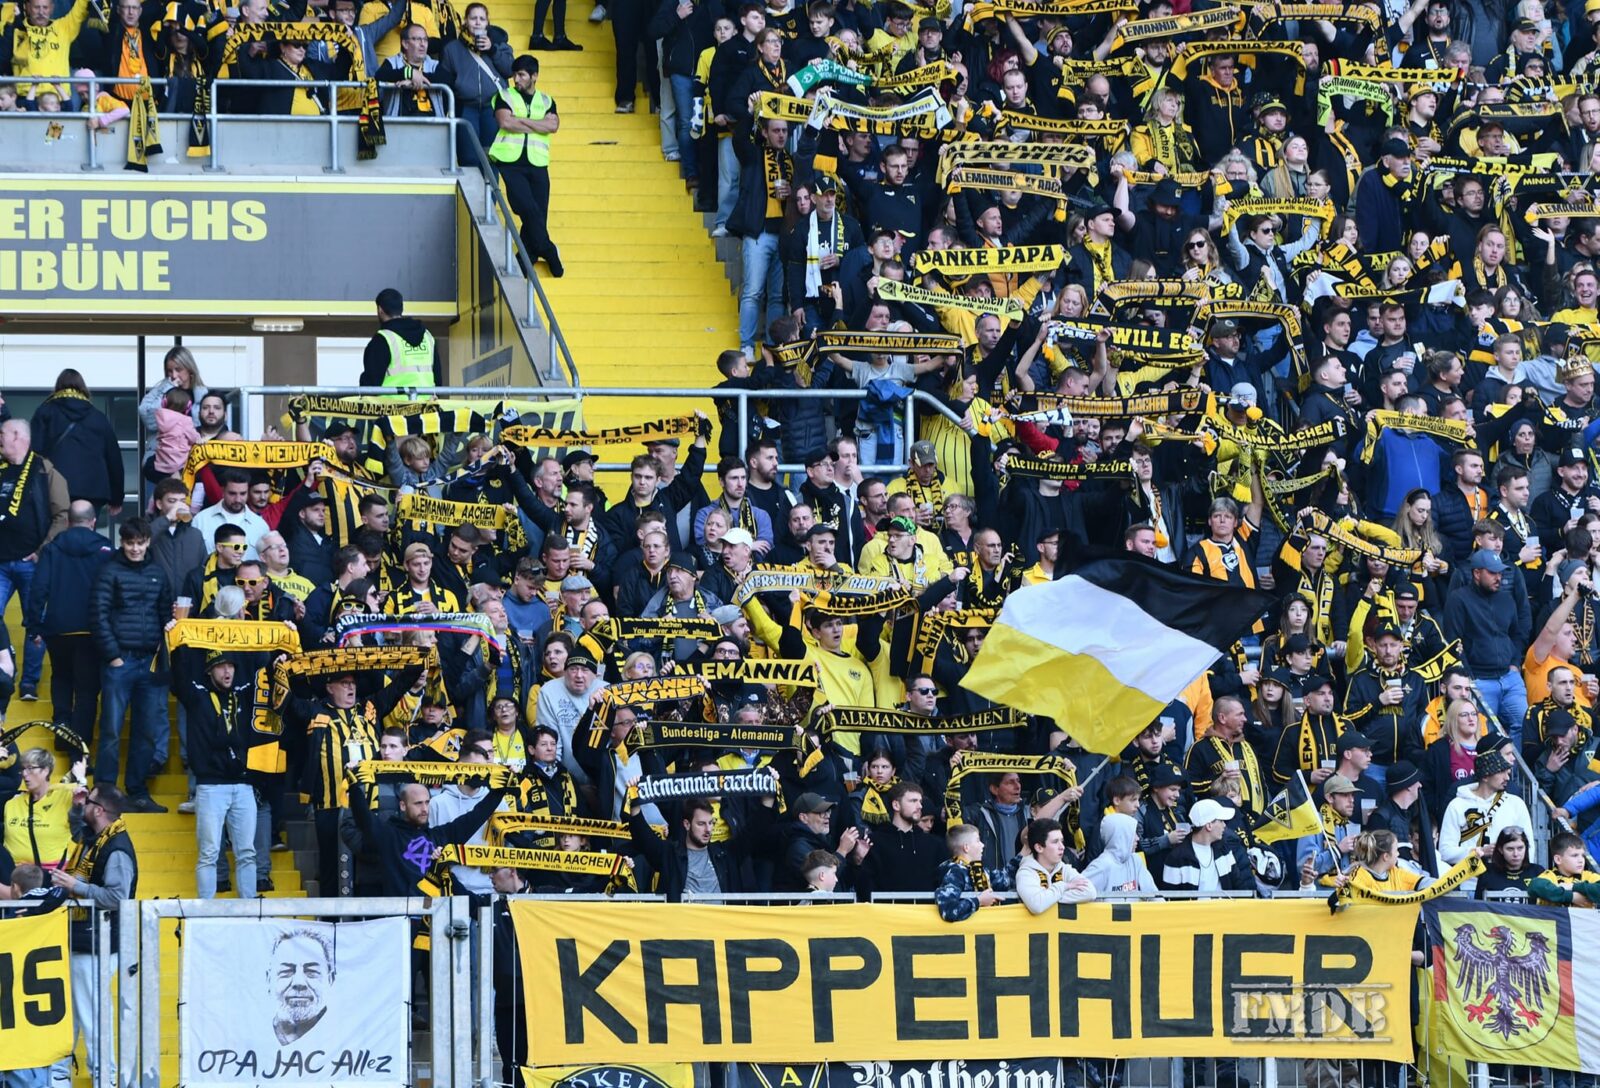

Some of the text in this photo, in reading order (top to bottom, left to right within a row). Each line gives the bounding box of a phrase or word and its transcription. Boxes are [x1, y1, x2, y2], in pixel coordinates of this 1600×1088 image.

[1182, 42, 1261, 59] ALEMANNIA
[922, 65, 940, 76] 2004
[1346, 69, 1453, 80] AACHEN
[833, 102, 932, 120] Alemannia Aachen
[1522, 177, 1556, 187] MINGE
[1298, 205, 1318, 214] alone
[82, 199, 267, 241] FUCHS
[919, 246, 1055, 267] DANKE PAPA
[903, 293, 999, 312] You'll never walk alone
[1214, 302, 1274, 313] ALEMANNIA
[824, 335, 846, 346] TSV
[848, 335, 914, 348] ALEMANNIA
[1110, 327, 1163, 348] WILL
[309, 396, 359, 414] ALEMANNIA
[1127, 396, 1169, 414] AACHEN
[531, 418, 664, 439] AACHEN
[1279, 421, 1334, 444] AACHEN
[565, 437, 632, 447] SINCE 1900
[265, 445, 299, 463] MEIN
[411, 496, 497, 521] ALEMANNIA AACHEN
[827, 586, 910, 608] ALEMANNIA
[336, 613, 387, 633] RADITION
[671, 628, 688, 636] walk
[180, 624, 291, 645] ALEMANNIA
[674, 661, 817, 683] ALEMANNIA
[611, 677, 701, 696] LEMANNI
[840, 709, 1004, 729] ALEMANNIA AACHEN
[661, 725, 720, 742] Bundesliga
[731, 729, 784, 742] Alemannia
[638, 775, 720, 800] alemannia
[497, 815, 526, 824] TSV
[530, 815, 618, 830] ALEMANNIA
[469, 847, 613, 868] TSV ALEMANNIA AACHEN
[555, 903, 1376, 1045] KAPPEHÄUER
[197, 1049, 257, 1077] OPA
[262, 1050, 325, 1079] JAC
